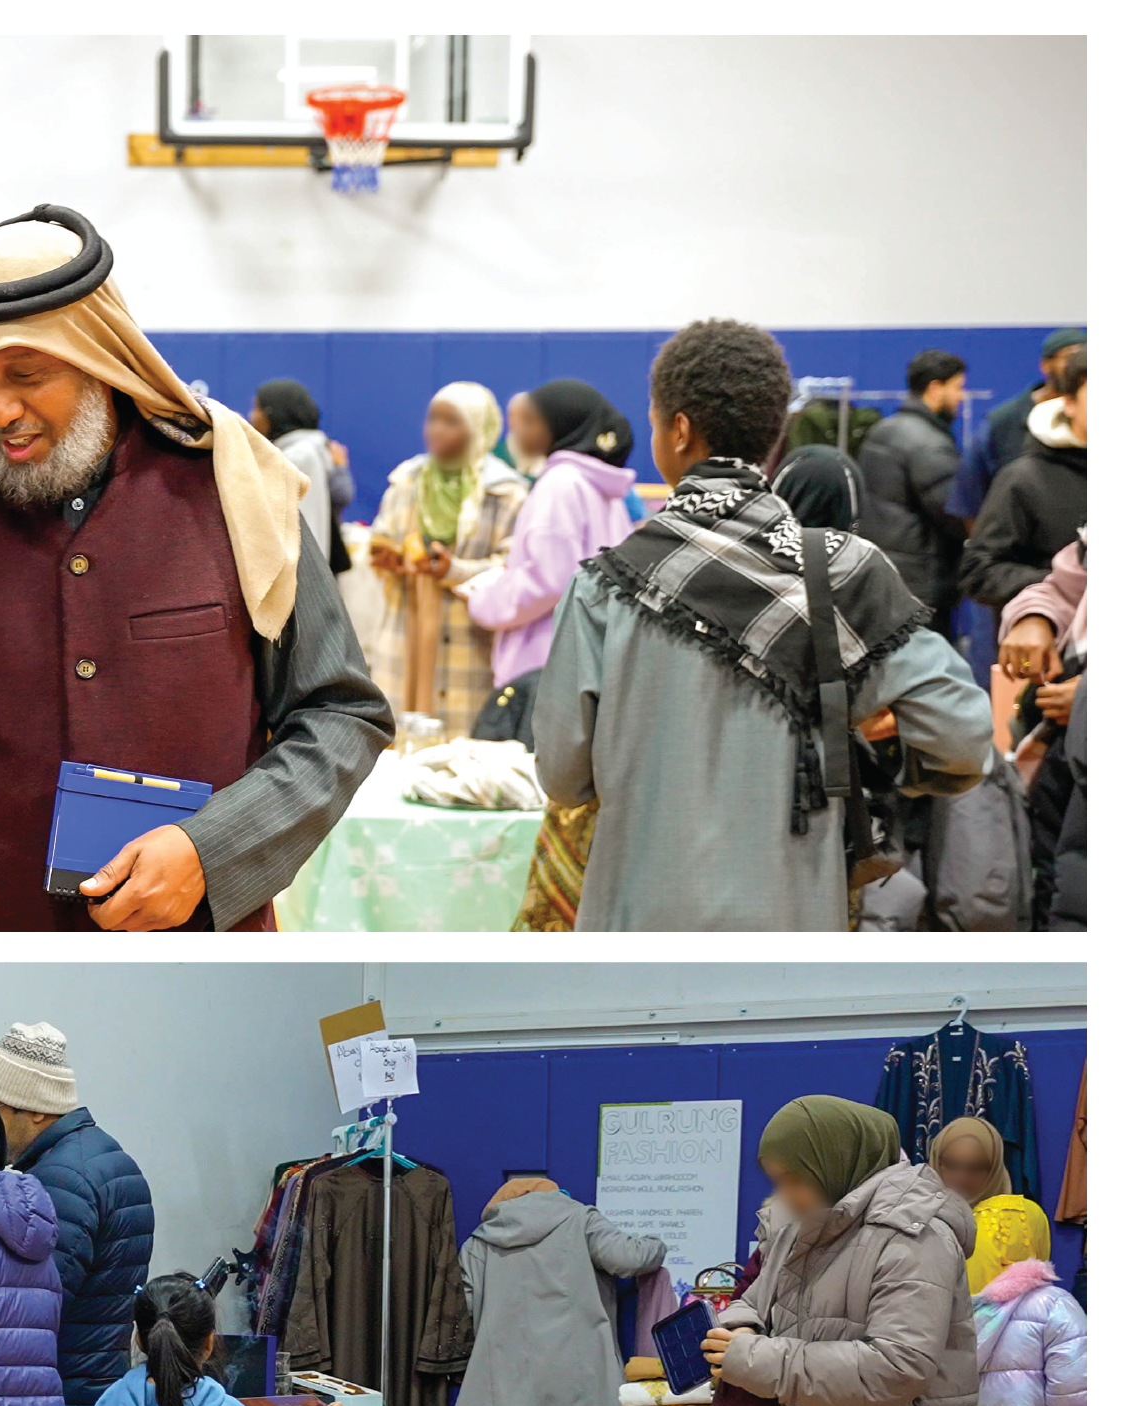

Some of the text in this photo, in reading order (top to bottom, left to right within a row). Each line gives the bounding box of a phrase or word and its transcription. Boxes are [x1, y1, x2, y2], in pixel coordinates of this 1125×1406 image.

[336, 1045, 361, 1059] Abay
[602, 1106, 739, 1136] GUL RUNG
[604, 1139, 722, 1165] FASHION
